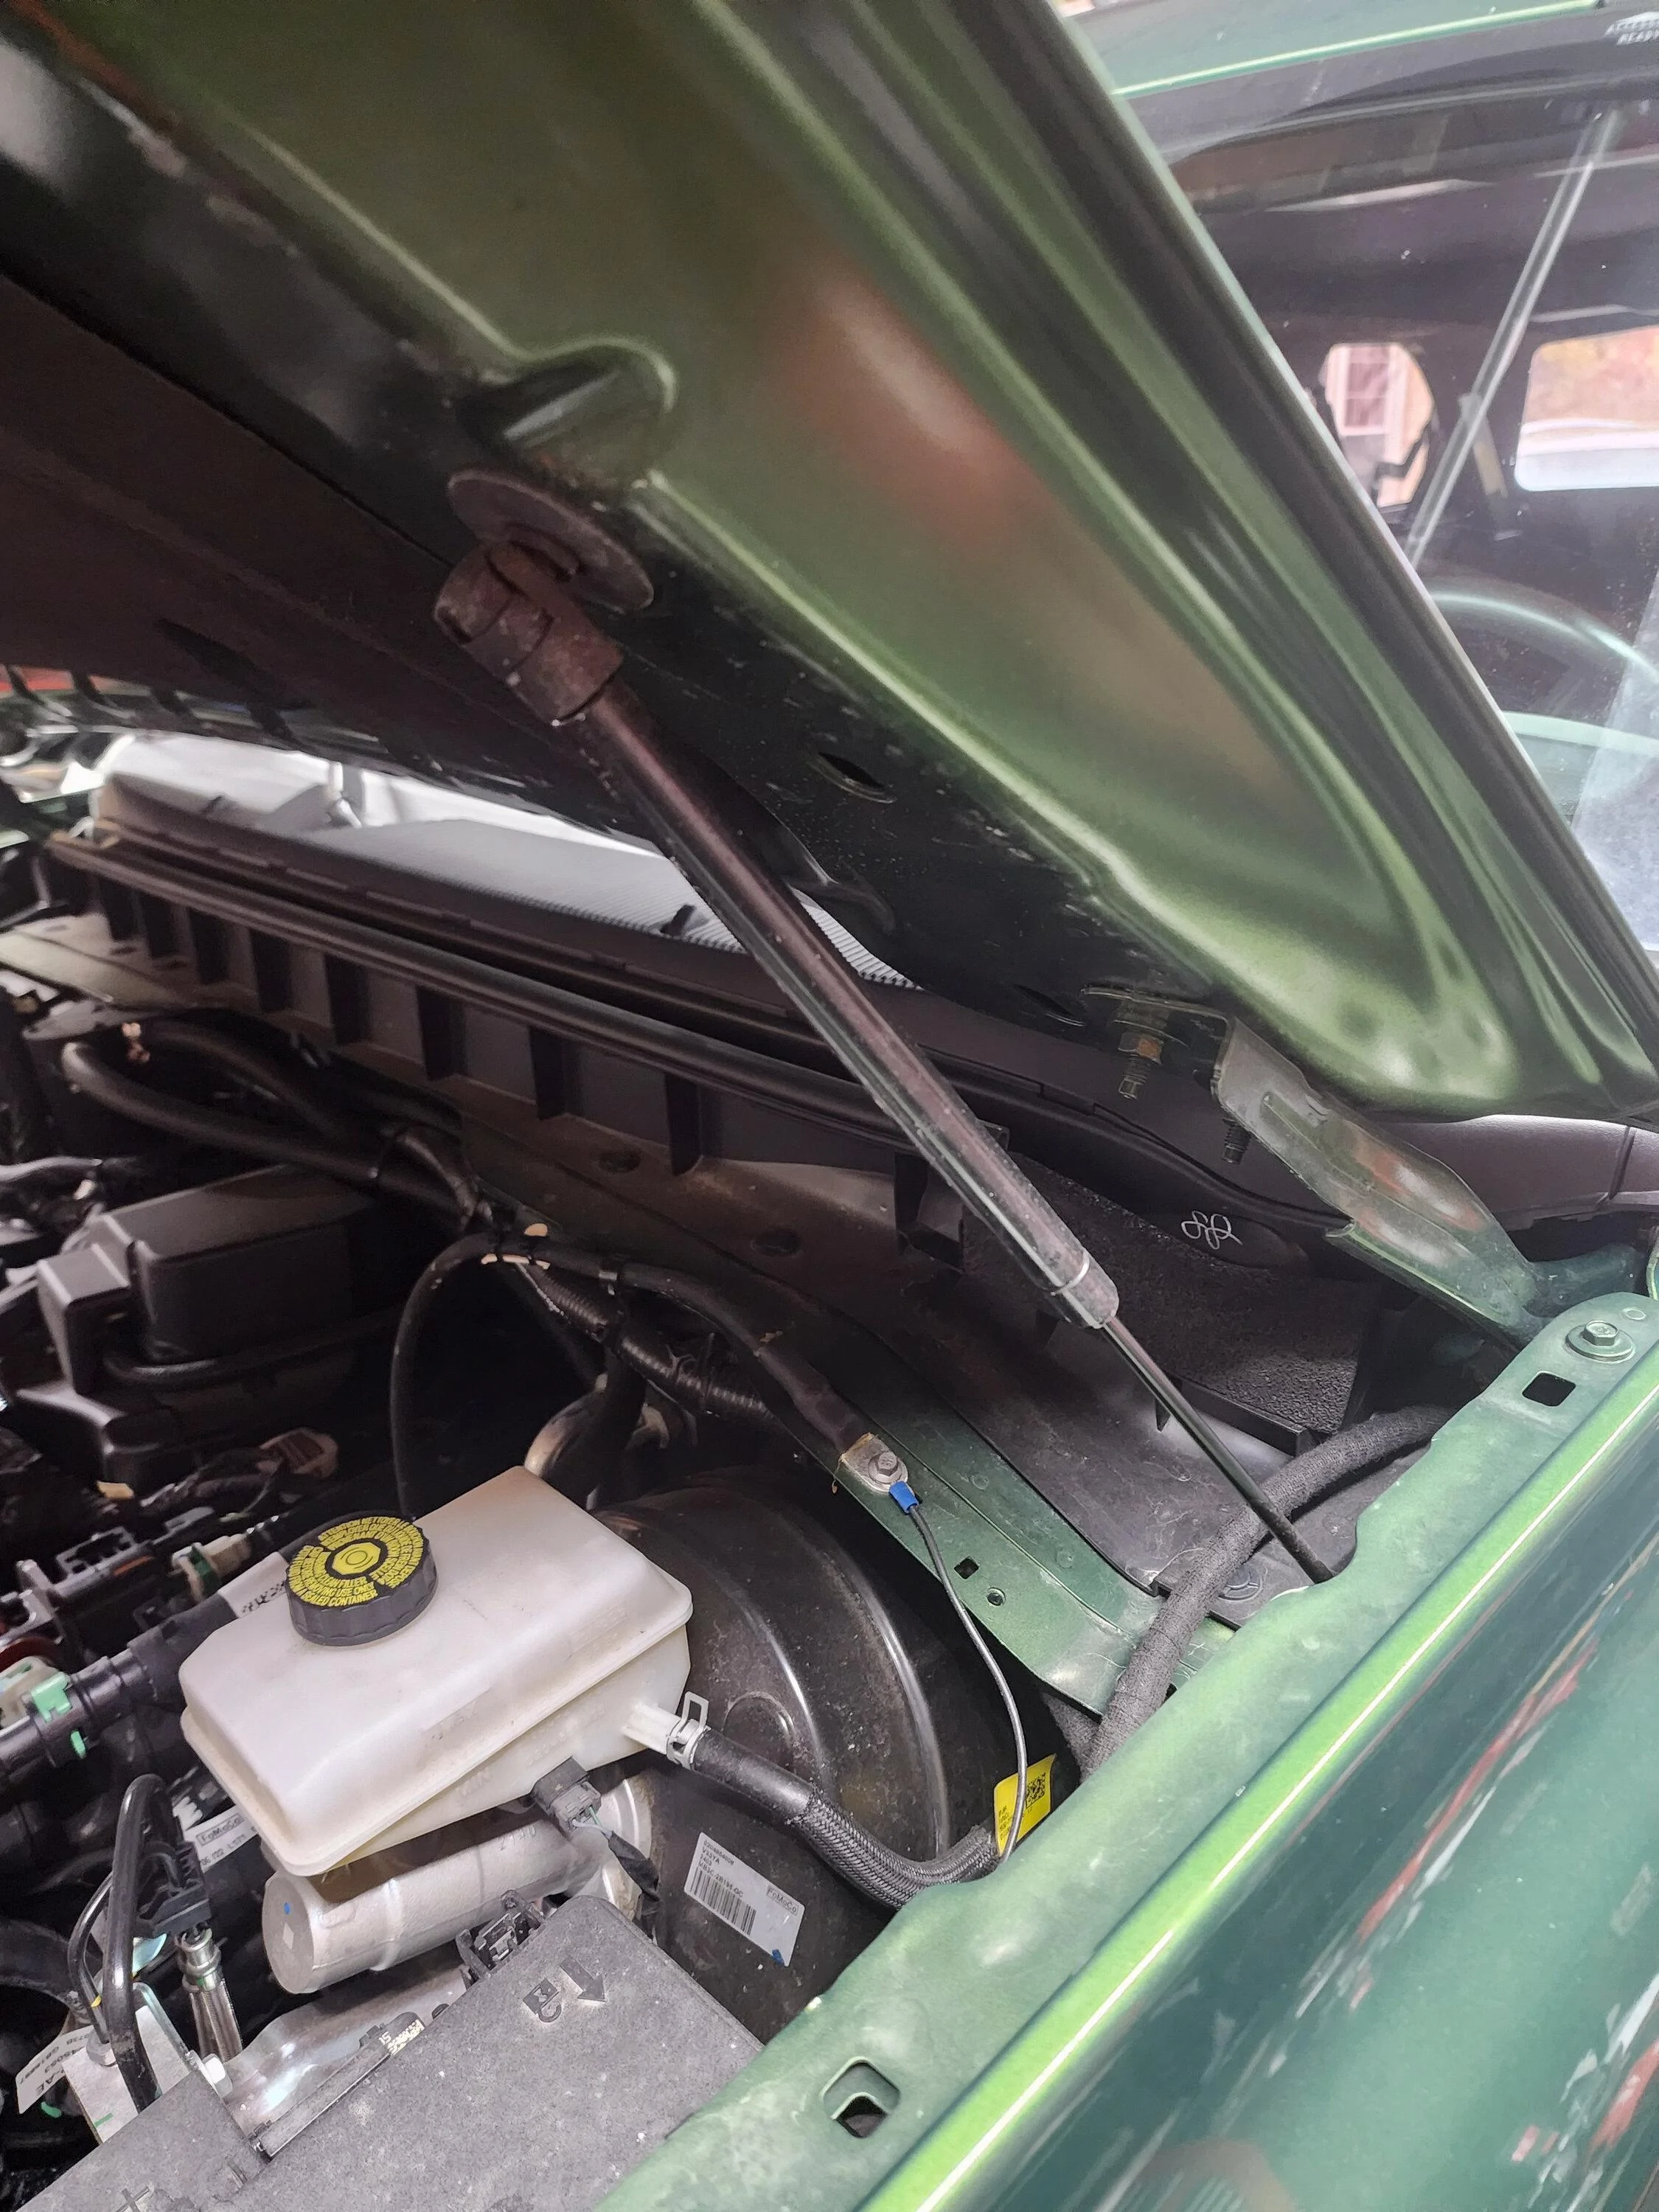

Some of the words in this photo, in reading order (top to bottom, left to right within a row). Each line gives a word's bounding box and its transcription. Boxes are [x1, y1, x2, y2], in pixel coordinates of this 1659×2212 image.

[303, 1576, 338, 1597] REMOVING
[332, 1587, 353, 1597] USE
[352, 1581, 375, 1596] ONLY
[317, 1573, 341, 1588] CLEAN
[335, 1575, 369, 1588] FILLER
[299, 1589, 331, 1606] SEALED
[325, 1587, 380, 1607] CONTAINER
[767, 1887, 798, 1913] FoMoCo
